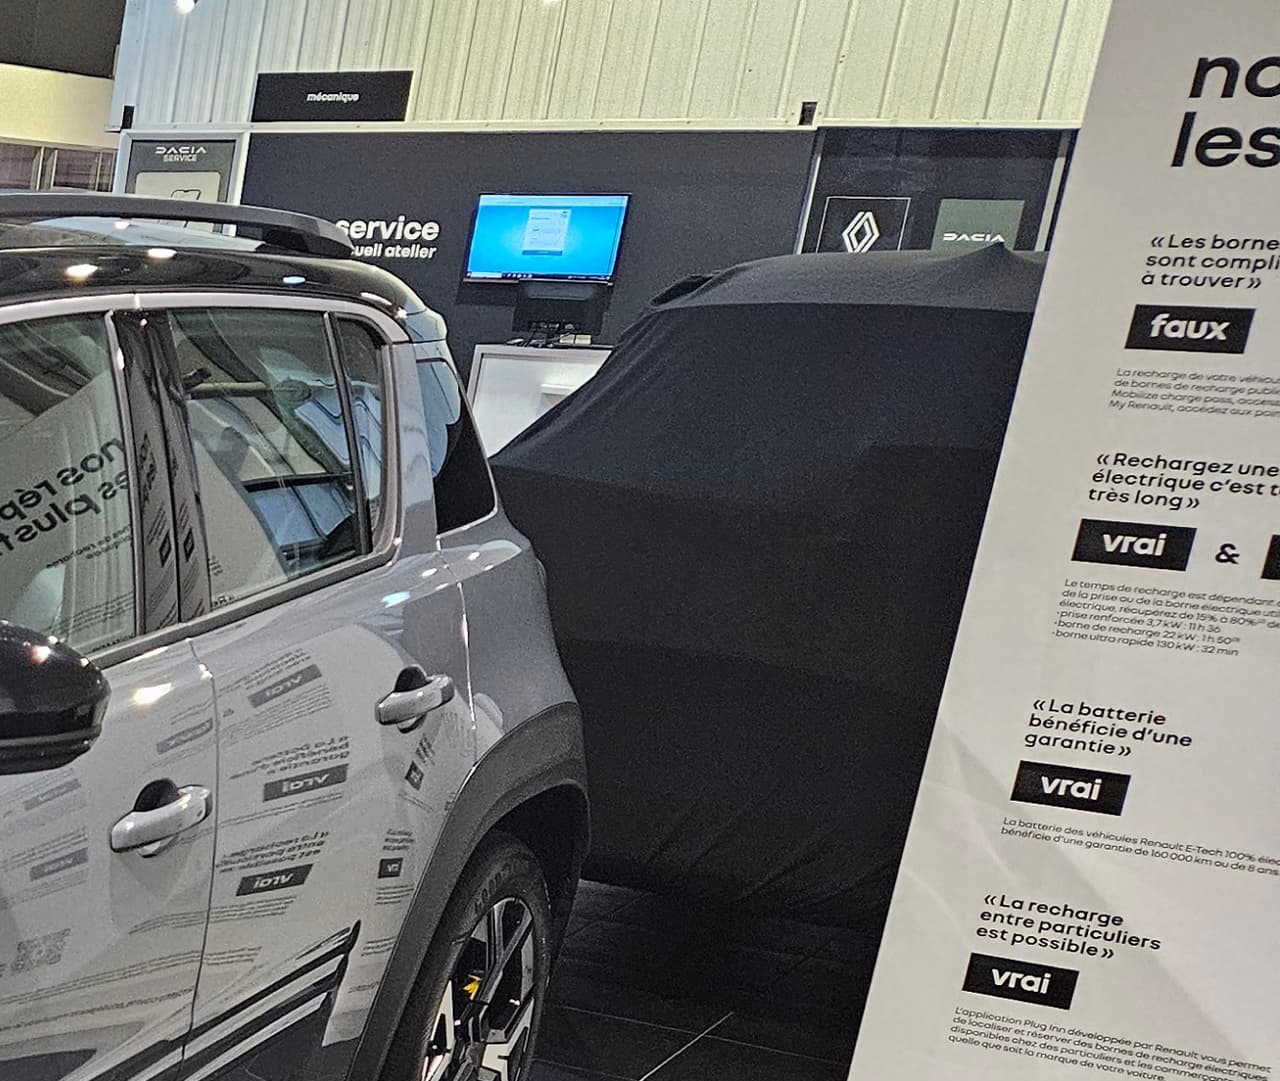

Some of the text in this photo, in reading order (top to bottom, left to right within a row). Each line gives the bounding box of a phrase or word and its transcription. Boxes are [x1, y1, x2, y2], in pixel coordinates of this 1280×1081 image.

[306, 91, 359, 103] mécanique
[154, 146, 207, 154] DACIA
[1170, 111, 1280, 168] les
[163, 154, 198, 163] SERVICE
[1167, 234, 1206, 248] Les
[1145, 255, 1197, 267] sont
[1141, 271, 1155, 285] à
[1160, 273, 1245, 288] trouver
[1150, 313, 1230, 340] faux
[1113, 452, 1233, 476] Rechargez
[1237, 464, 1279, 477] une
[1092, 468, 1205, 492] électrique
[1209, 479, 1264, 495] c'est
[1088, 487, 1130, 503] très
[1134, 489, 1183, 510] long
[1102, 533, 1240, 564] vrai &
[1048, 698, 1074, 714] La
[1078, 701, 1166, 725] batterie
[1028, 713, 1192, 746] bénéficie d'une
[1024, 733, 1115, 754] garantie
[1041, 775, 1102, 800] vrai
[999, 894, 1024, 910] La
[1028, 901, 1123, 927] recharge
[976, 927, 1008, 941] est
[1010, 932, 1098, 956] possible
[980, 911, 1160, 950] entre particuliers
[991, 968, 1051, 994] vrai
[954, 1007, 1022, 1025] L'application
[1023, 1019, 1047, 1032] Plug
[1066, 1028, 1132, 1046] développée
[1132, 1041, 1154, 1050] par
[1154, 1043, 1199, 1059] Renault
[1200, 1054, 1227, 1064] vous
[1226, 1059, 1271, 1073] permet
